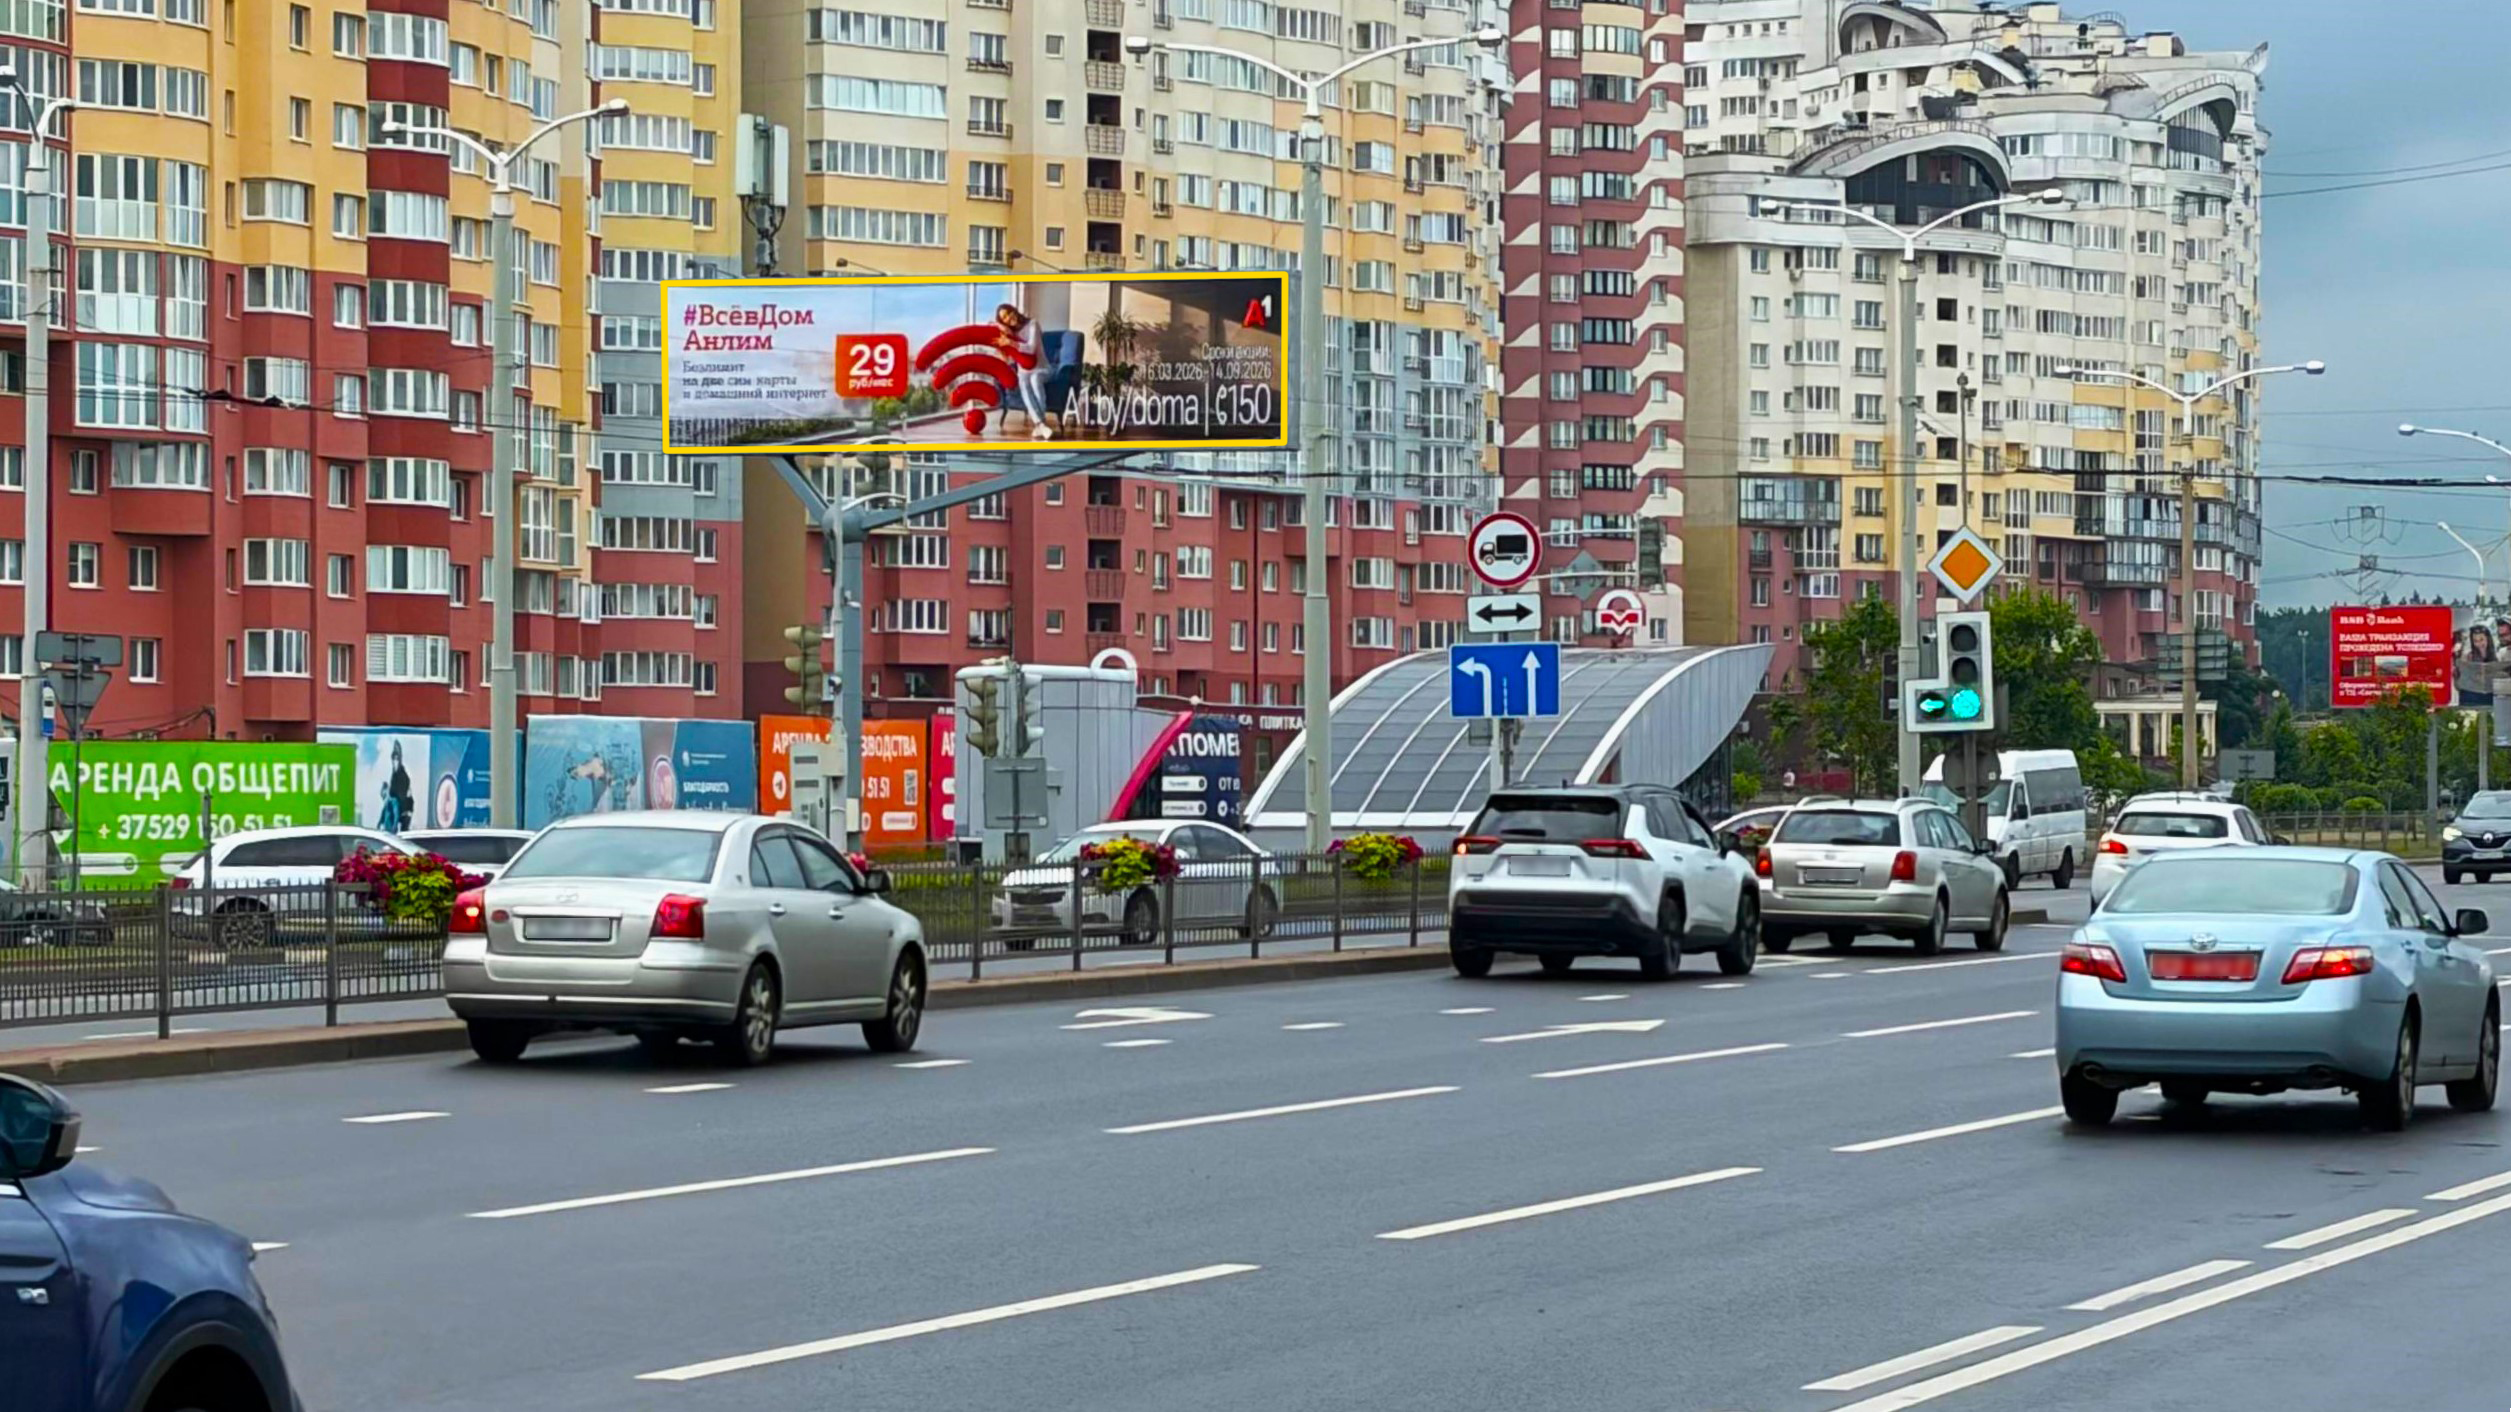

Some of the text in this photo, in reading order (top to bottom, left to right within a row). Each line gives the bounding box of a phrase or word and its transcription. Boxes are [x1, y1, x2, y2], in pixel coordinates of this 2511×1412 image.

[683, 303, 815, 330] #ВсёвДом
[1243, 294, 1272, 329] A1
[683, 330, 773, 351] Анлим
[683, 361, 745, 374] Безлимит
[849, 343, 895, 376] 29
[683, 377, 698, 386] на
[701, 377, 724, 388] две
[756, 376, 797, 388] карты
[695, 388, 763, 400] домашний
[766, 389, 827, 402] интернет
[1062, 384, 1199, 436] A1.by/doma
[49, 762, 183, 801] АРЕНДА
[192, 761, 341, 801] ОБЩЕПИТ
[116, 813, 191, 840] 37529
